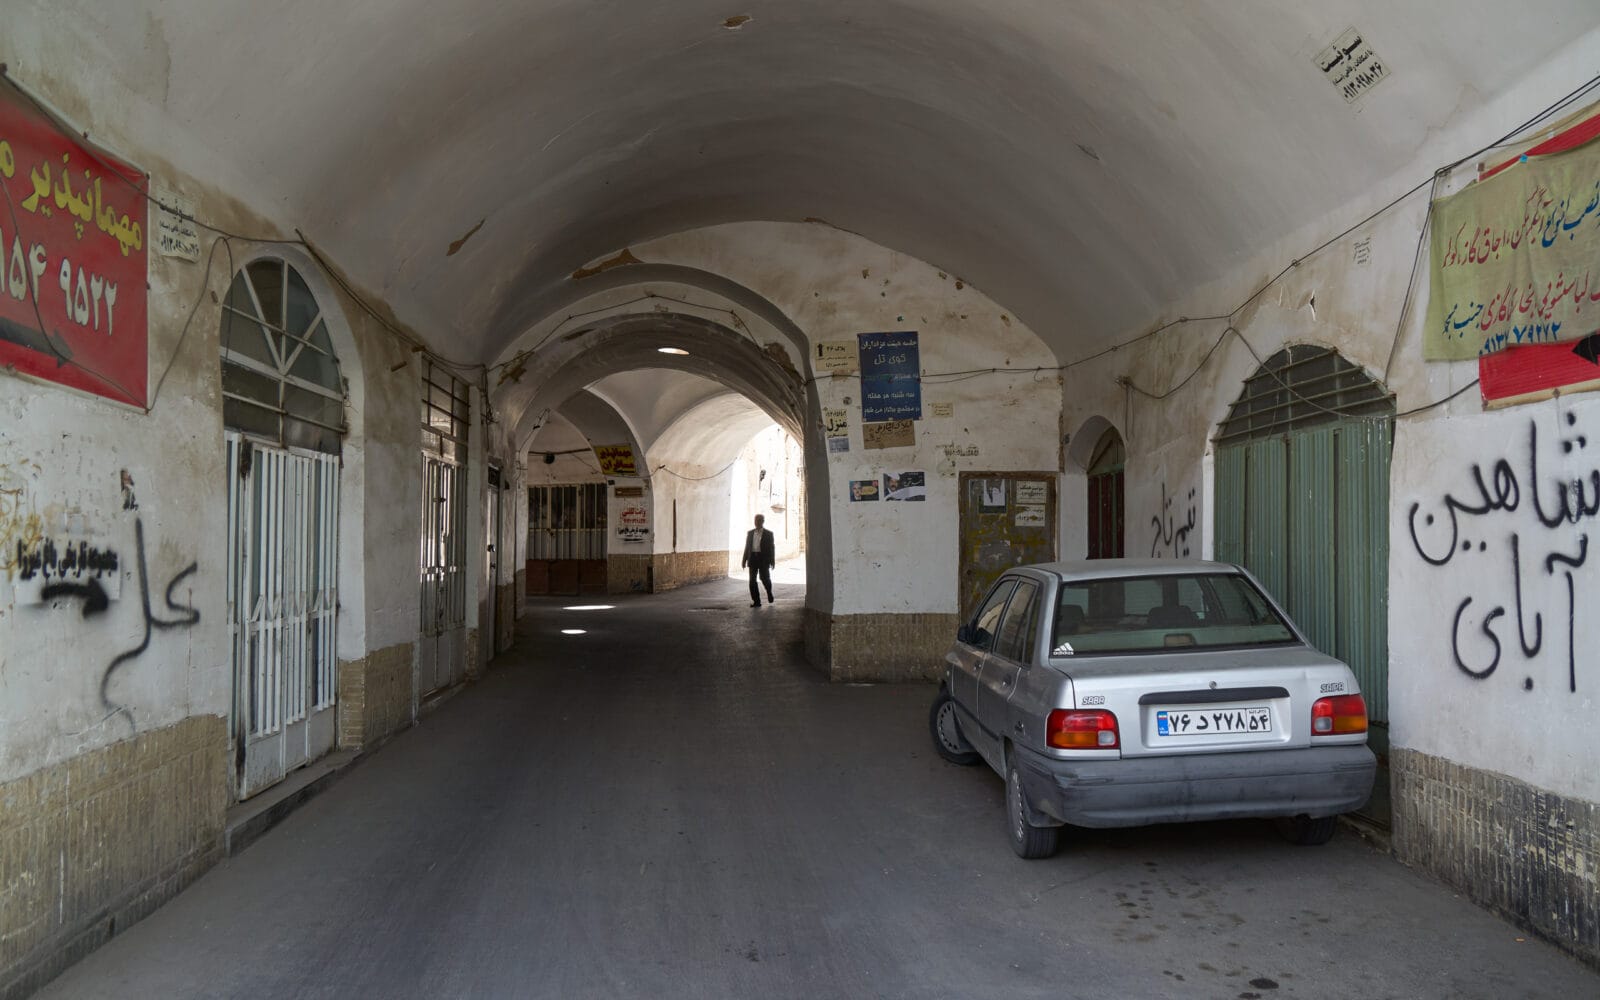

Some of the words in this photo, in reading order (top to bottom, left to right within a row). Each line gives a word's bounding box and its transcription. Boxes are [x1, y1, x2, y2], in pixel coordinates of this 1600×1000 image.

[22, 153, 143, 257] مهمانپذیر
[58, 257, 117, 336] ۹۵۲۲
[1409, 411, 1600, 568] شاهین
[1320, 682, 1345, 693] SAIPA
[1081, 695, 1106, 706] SABA
[1212, 711, 1246, 731] ۲۷۸
[1249, 714, 1269, 731] ۵۴
